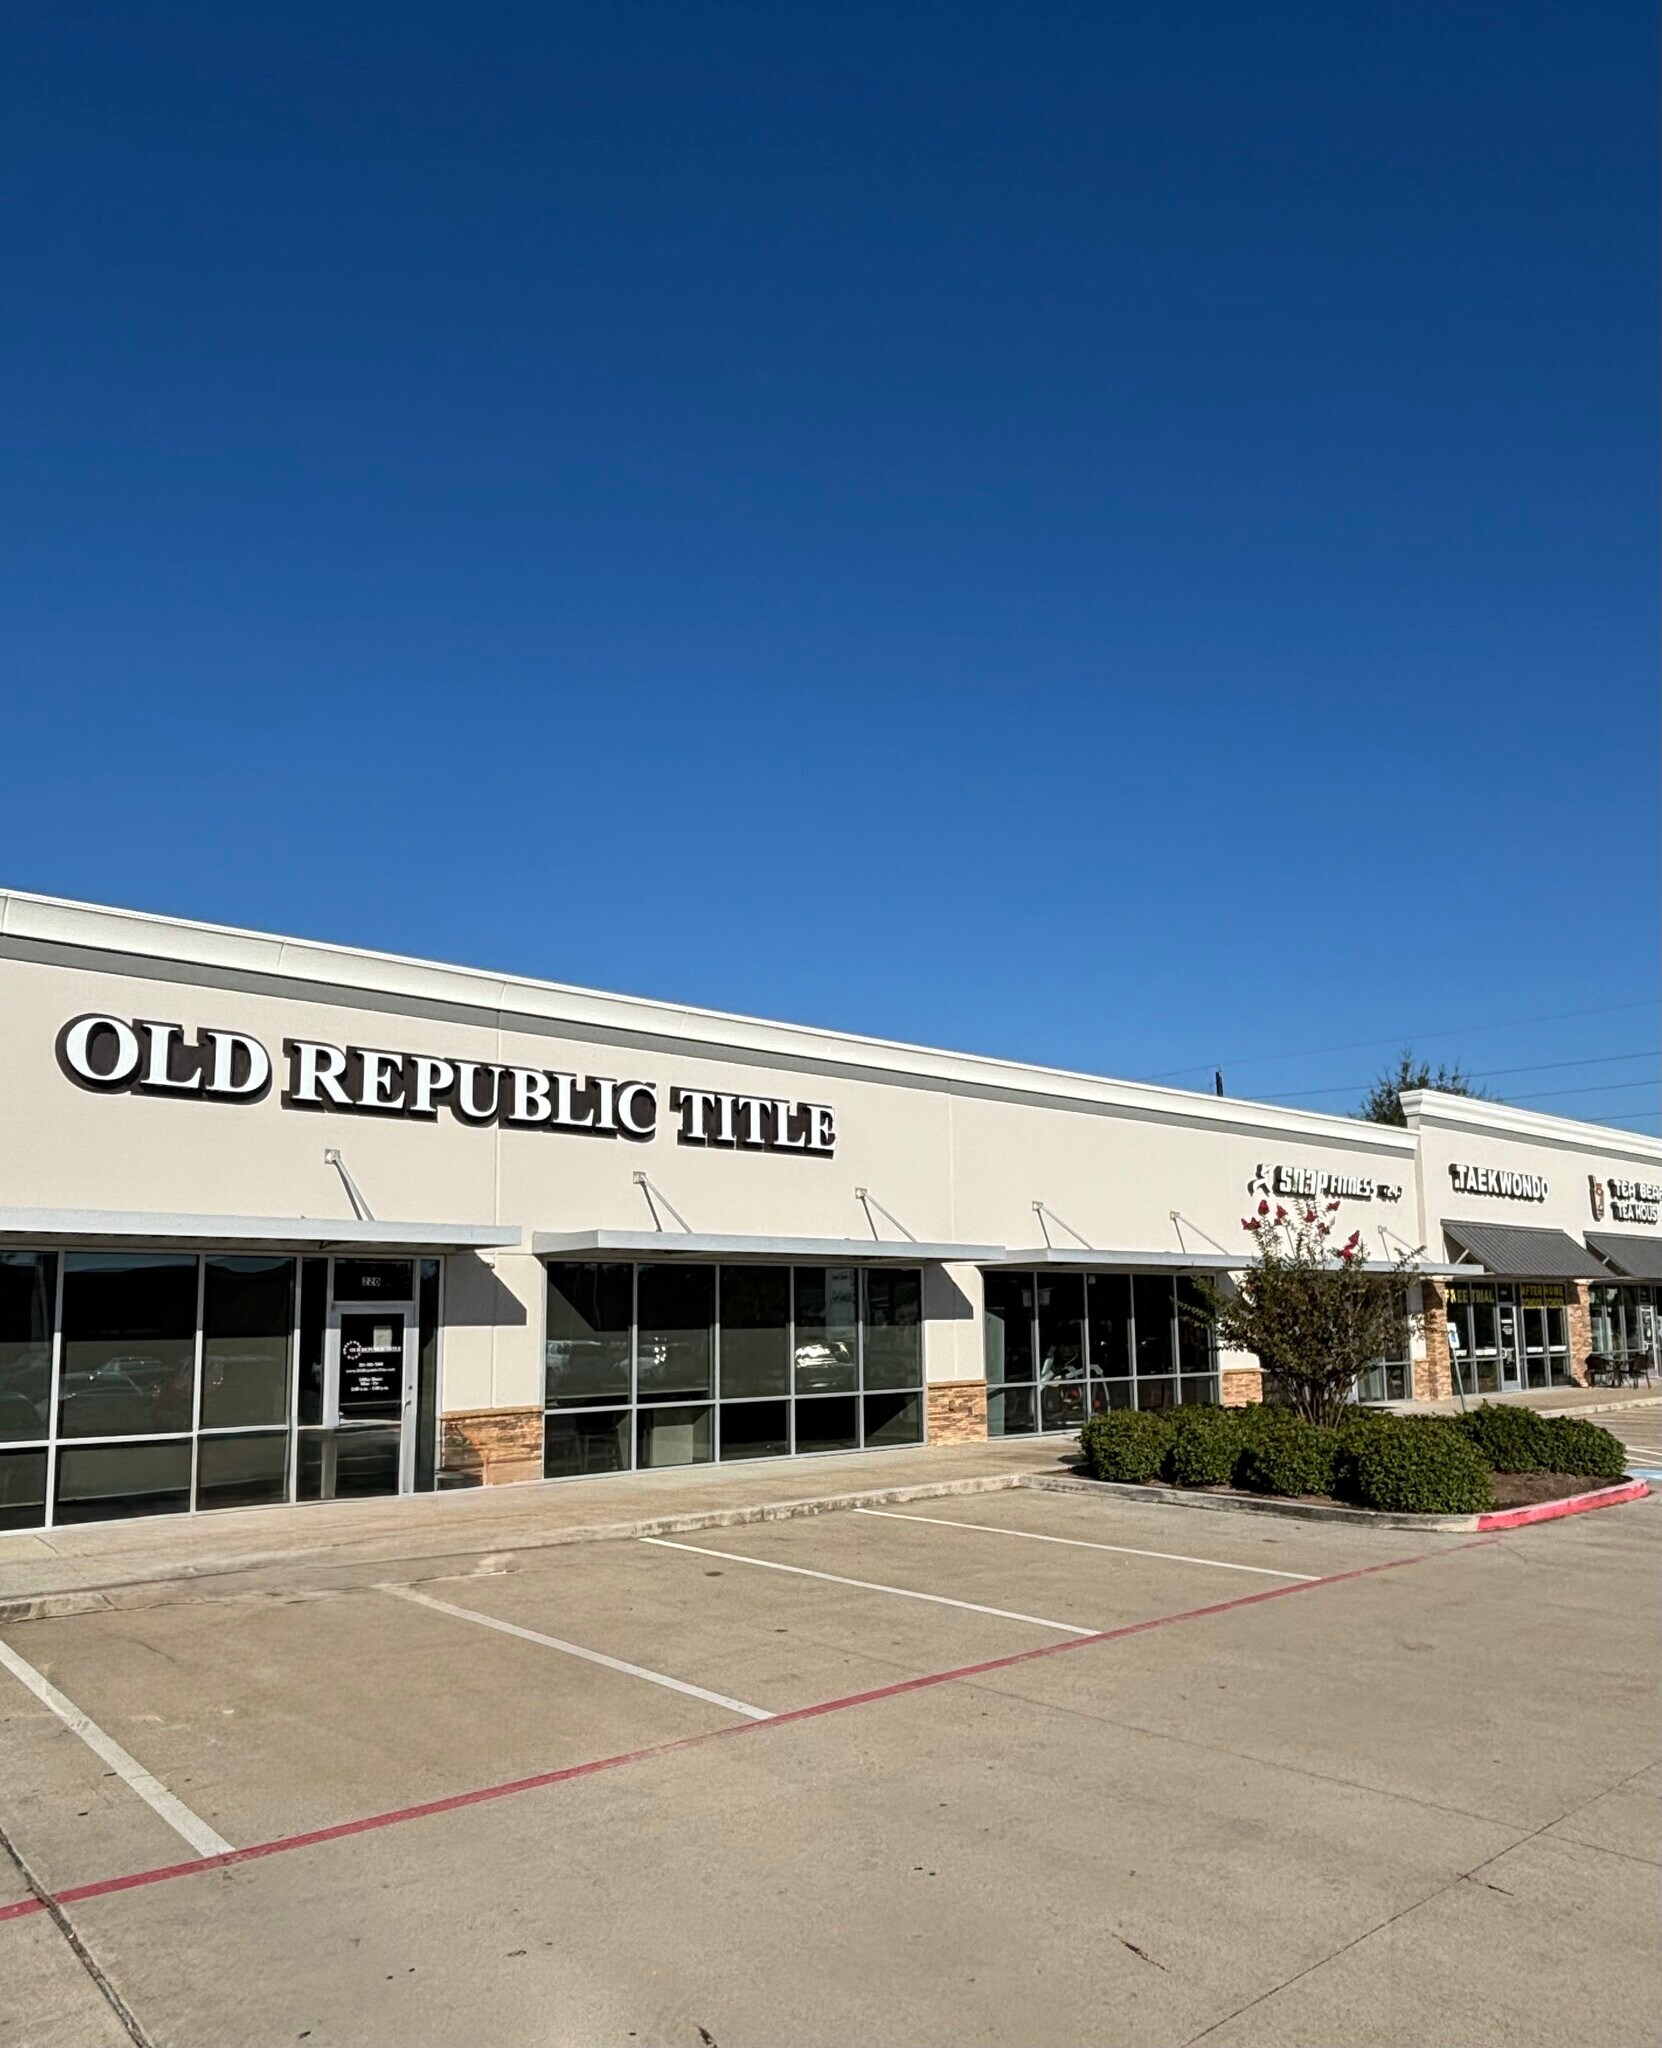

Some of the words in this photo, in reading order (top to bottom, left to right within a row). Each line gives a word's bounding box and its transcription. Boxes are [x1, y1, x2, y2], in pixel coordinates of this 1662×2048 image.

[65, 1016, 270, 1094] OLD
[291, 1042, 658, 1135] REPUBLIC
[678, 1090, 837, 1151] TITLE
[1455, 1164, 1550, 1199] TAEKWONDO
[1613, 1179, 1636, 1198] TEA
[1639, 1182, 1662, 1201] BEA
[1616, 1202, 1635, 1220] TEA
[362, 1276, 381, 1287] 220
[1470, 1288, 1495, 1304] TRIAL
